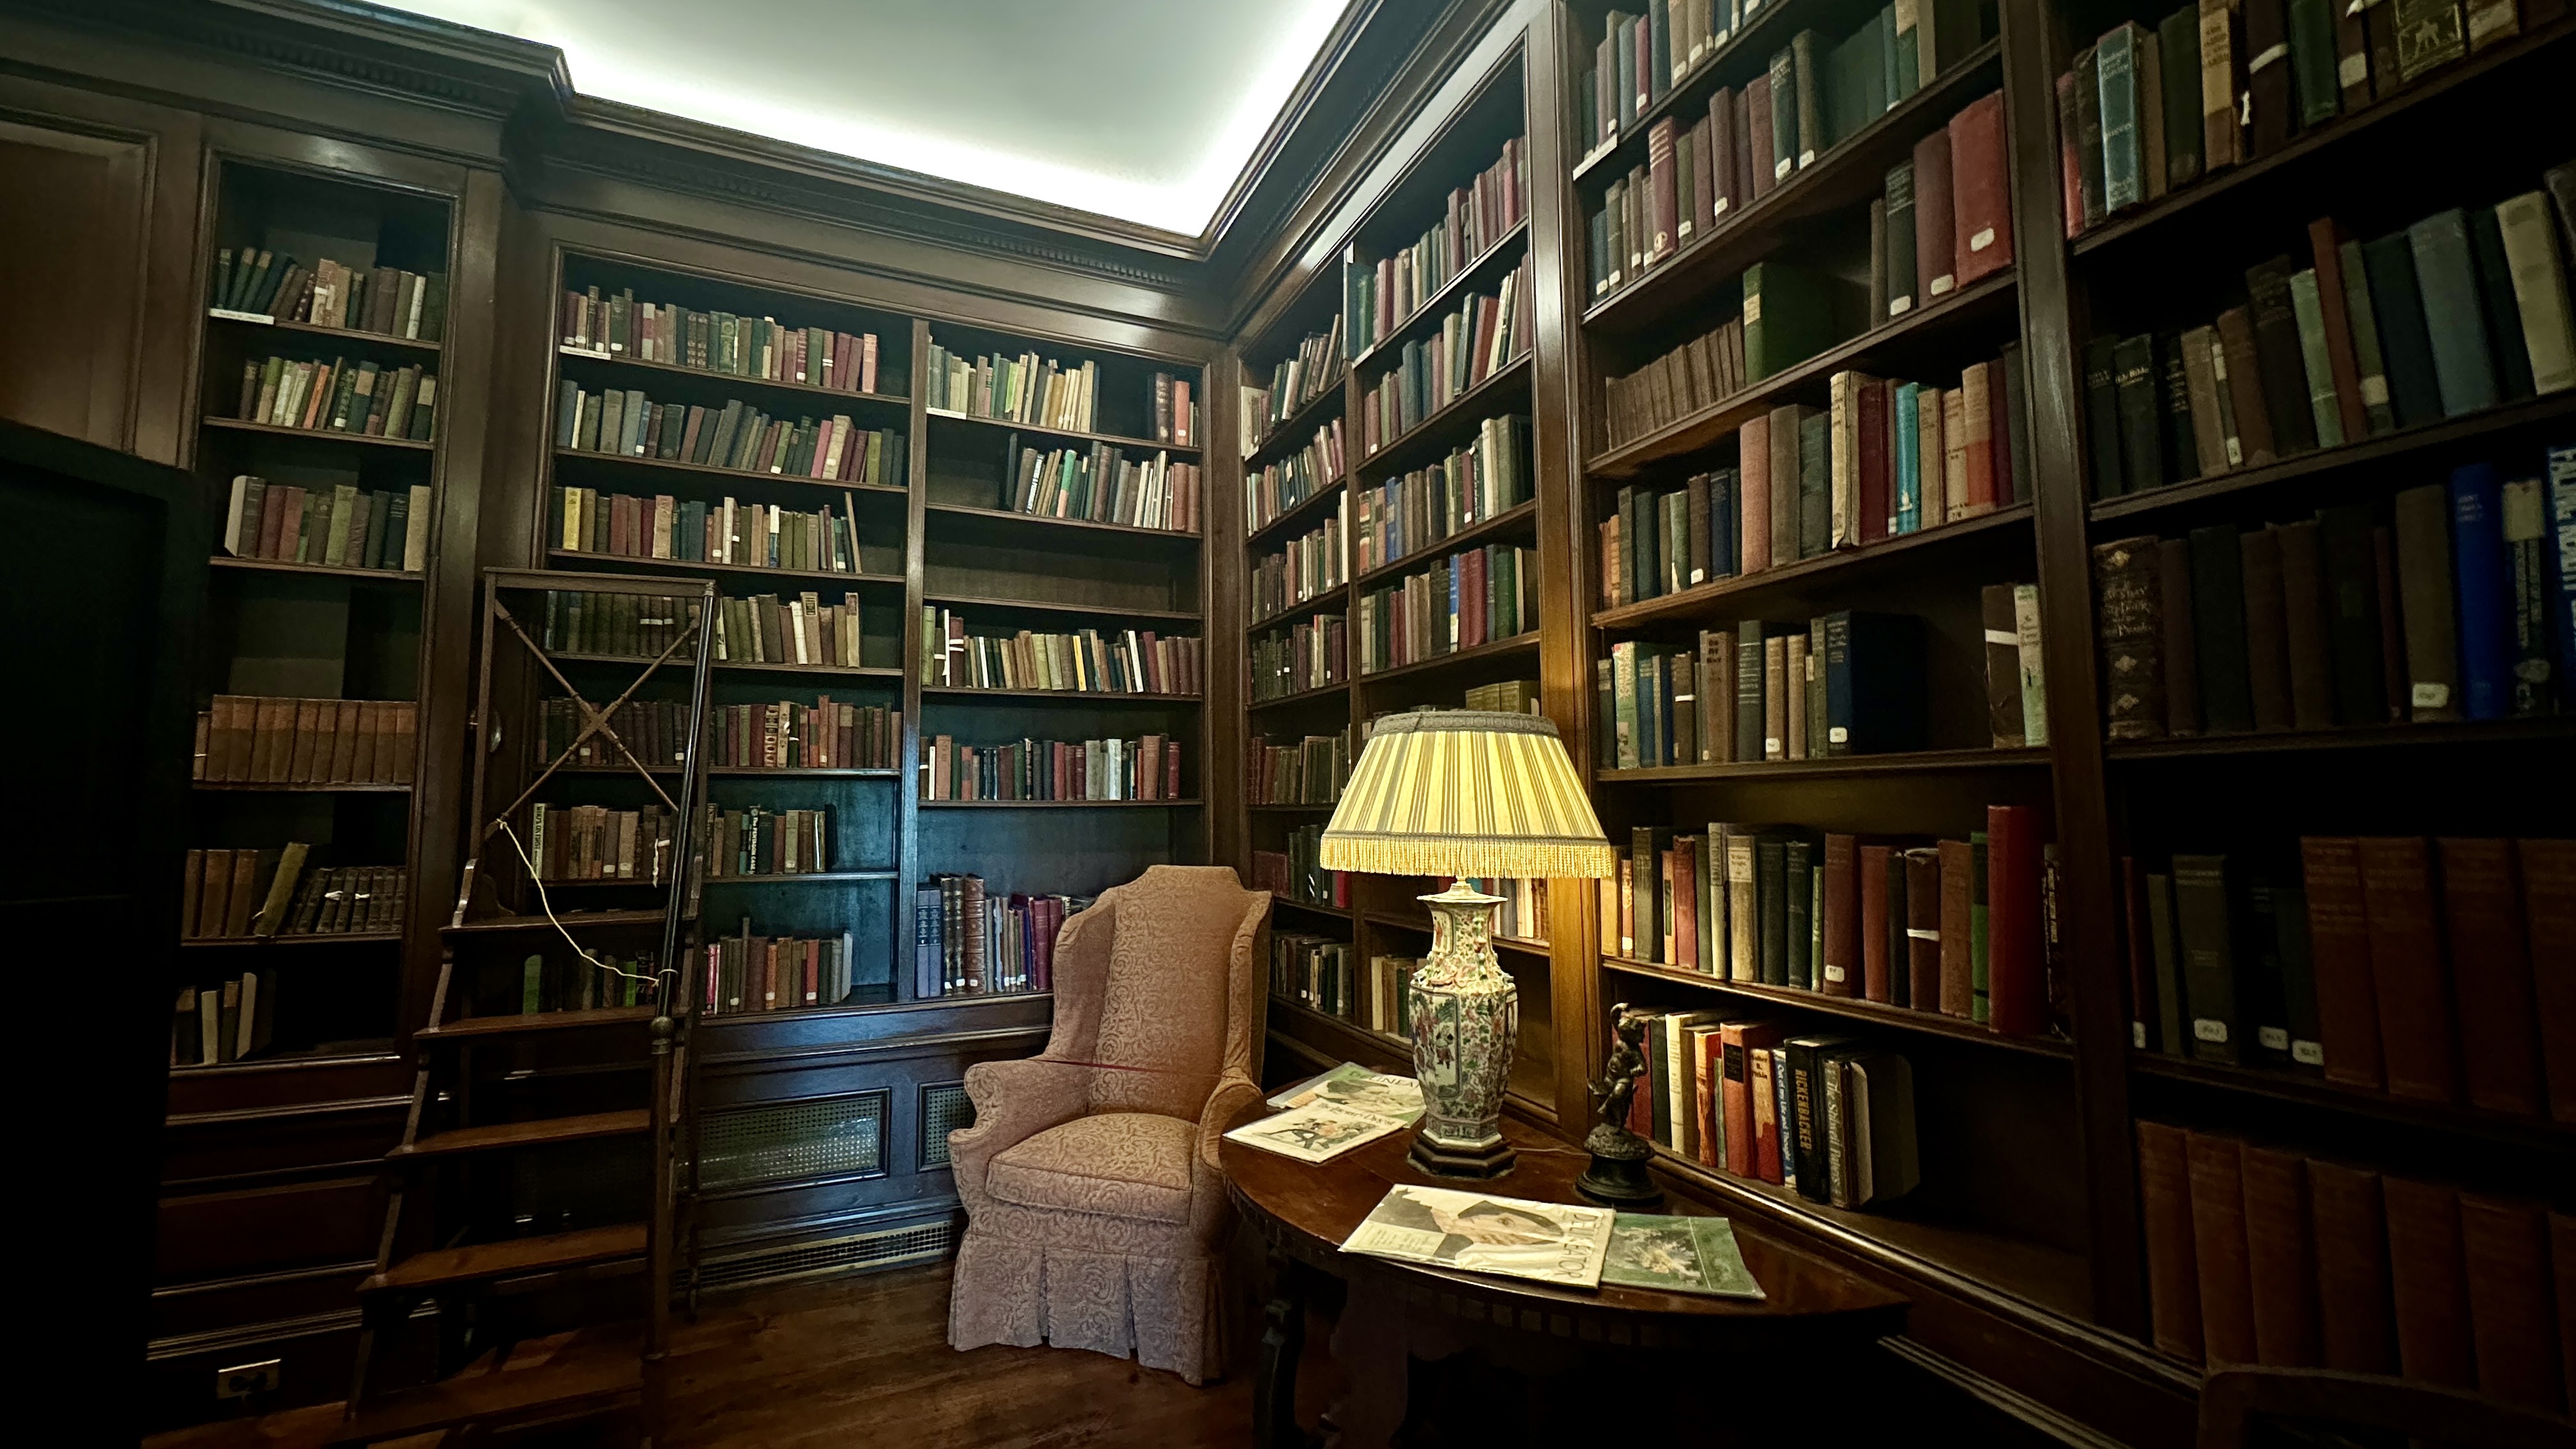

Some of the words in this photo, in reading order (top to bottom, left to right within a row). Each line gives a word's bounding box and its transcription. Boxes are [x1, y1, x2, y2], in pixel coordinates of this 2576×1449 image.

[1795, 1069, 1813, 1151] RICKENBACKER
[1827, 1081, 1841, 1100] The
[1827, 1101, 1844, 1148] Stilwell
